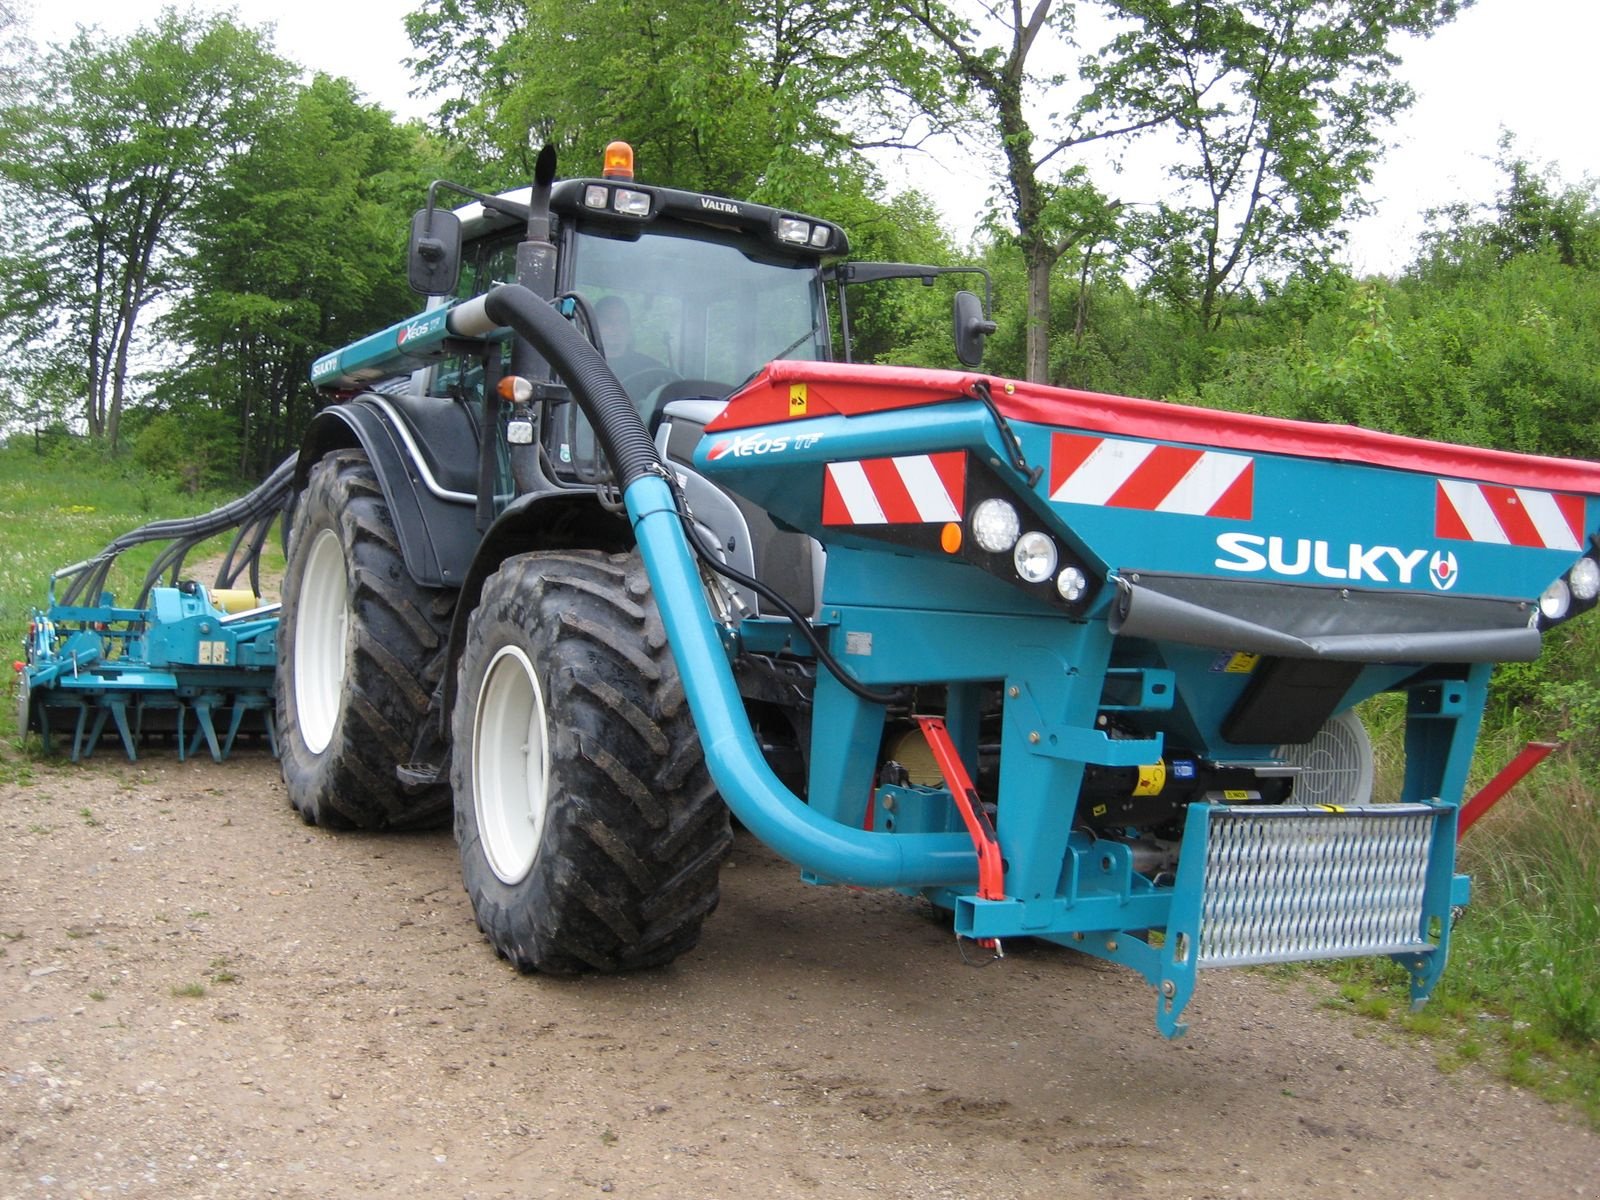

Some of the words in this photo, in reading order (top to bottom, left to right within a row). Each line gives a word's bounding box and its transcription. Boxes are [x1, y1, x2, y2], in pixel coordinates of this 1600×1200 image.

[701, 198, 738, 214] VALTRA
[794, 432, 824, 450] TF
[1216, 532, 1428, 583] SULKY
